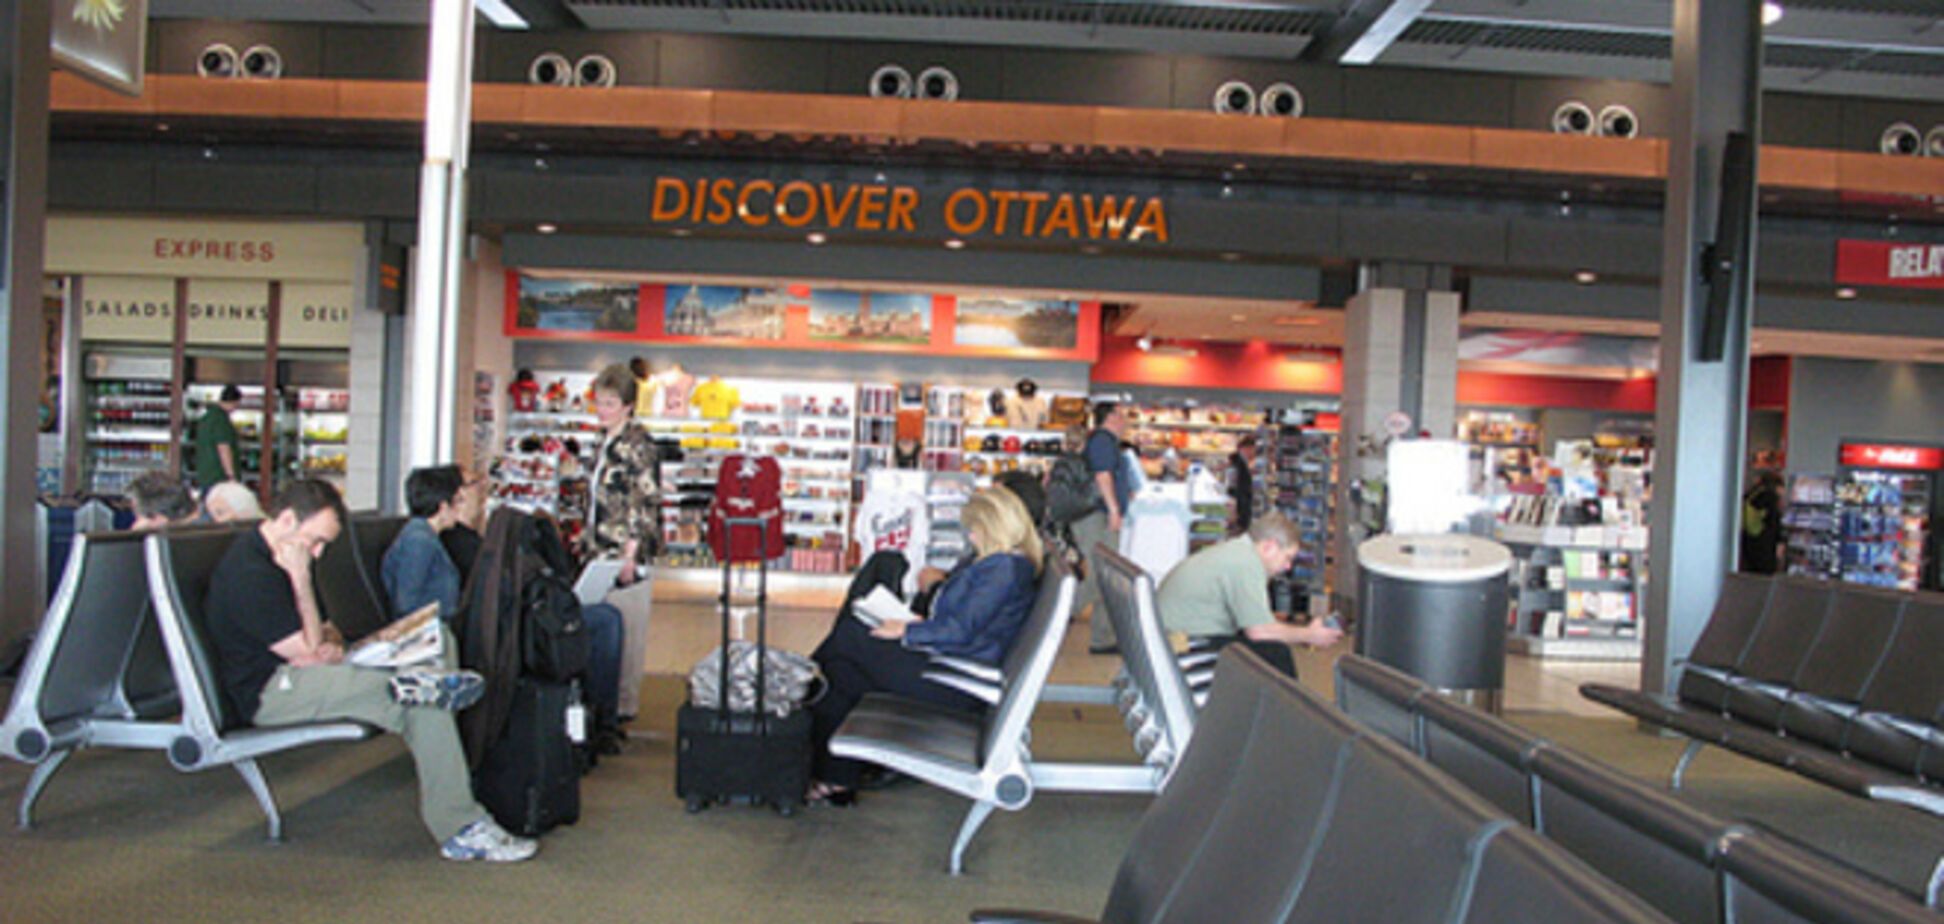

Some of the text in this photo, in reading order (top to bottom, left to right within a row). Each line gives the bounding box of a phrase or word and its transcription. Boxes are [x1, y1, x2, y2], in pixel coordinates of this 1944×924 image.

[651, 176, 1168, 242] DISCOVER OTTAWA
[154, 237, 275, 262] EXPRESS
[84, 301, 171, 317] SALADS
[188, 303, 269, 320] DRINKS
[303, 305, 348, 321] DELI
